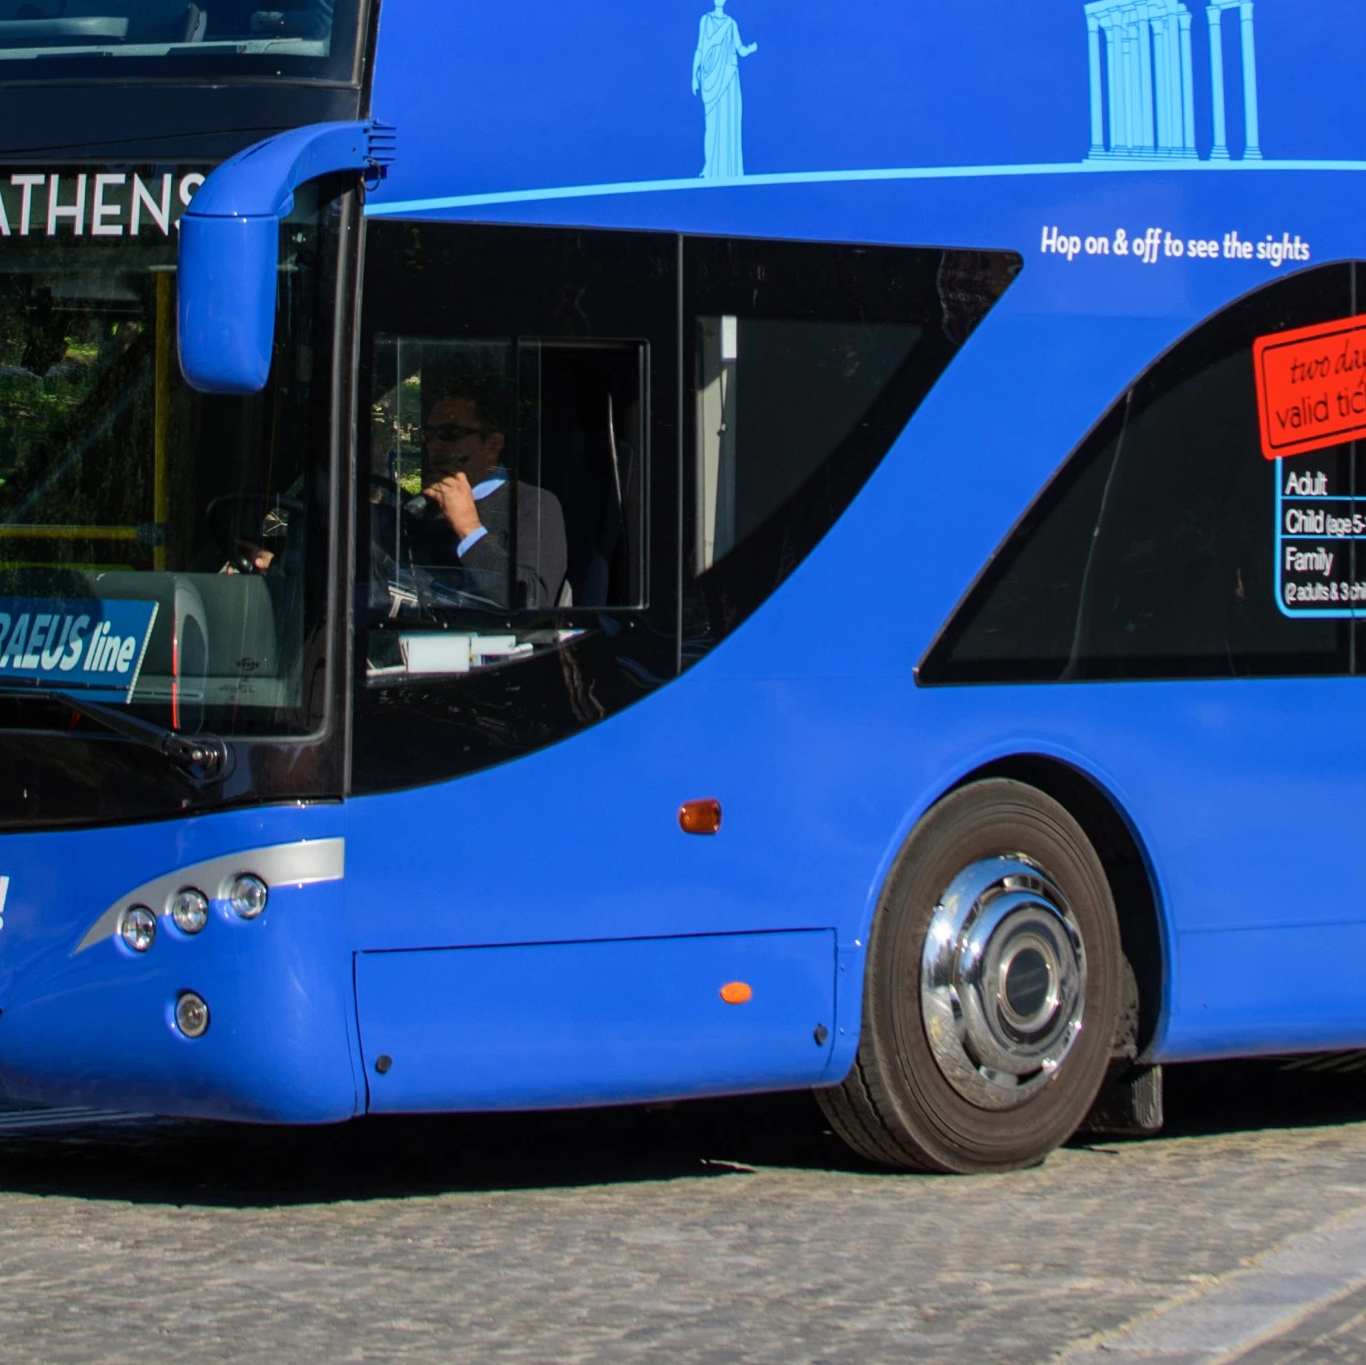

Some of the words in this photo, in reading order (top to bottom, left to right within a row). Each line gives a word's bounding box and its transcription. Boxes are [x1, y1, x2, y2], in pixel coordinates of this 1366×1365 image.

[1040, 226, 1082, 261] Hop
[1085, 236, 1109, 255] on
[1113, 228, 1129, 255] &
[1132, 228, 1162, 263] off
[1164, 232, 1185, 257] to
[1186, 239, 1219, 258] see
[1223, 231, 1253, 259] the
[1256, 232, 1310, 267] sights
[1290, 356, 1331, 384] two
[1276, 392, 1329, 430] valid
[1285, 471, 1328, 496] Adult
[1285, 509, 1324, 533] Child
[1326, 514, 1352, 538] (age
[1285, 546, 1334, 576] Family
[1297, 582, 1329, 601] adults
[83, 620, 136, 673] line
